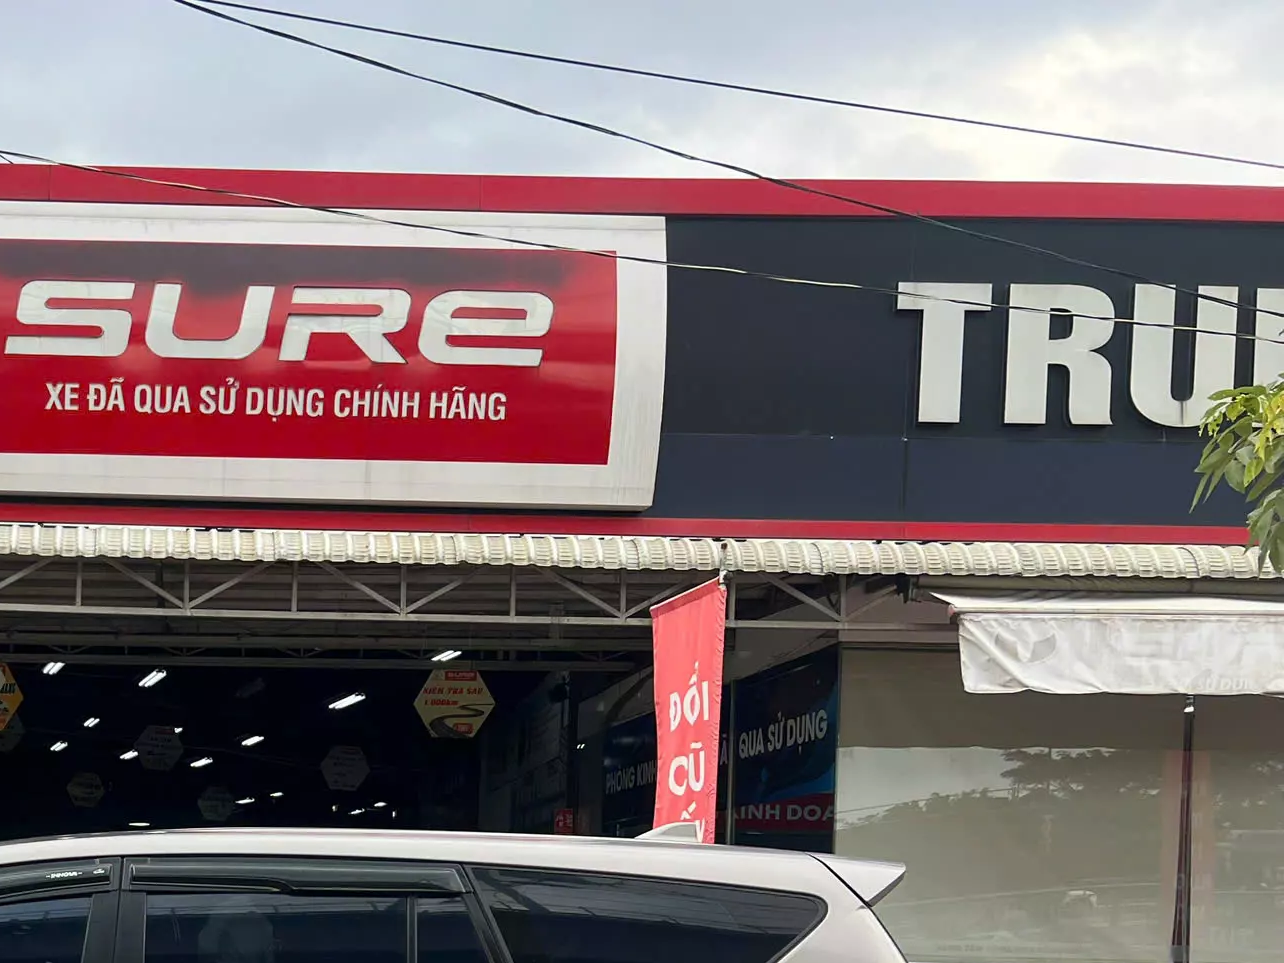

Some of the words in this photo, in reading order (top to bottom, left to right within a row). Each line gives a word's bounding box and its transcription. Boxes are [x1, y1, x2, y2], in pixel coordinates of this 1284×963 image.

[44, 382, 80, 411] XE
[87, 377, 125, 412] ĐÃ
[134, 384, 191, 415] QUA
[199, 376, 240, 415] SỬ
[245, 386, 324, 422] DỤNG
[334, 383, 420, 419] CHÍNH
[429, 386, 507, 421] HÃNG
[669, 661, 710, 732] ĐỔI
[739, 727, 765, 759] QUA
[768, 712, 785, 751] SỬ
[786, 709, 828, 756] DỤNG
[668, 742, 706, 796] CŨ
[787, 804, 835, 821] DOA
